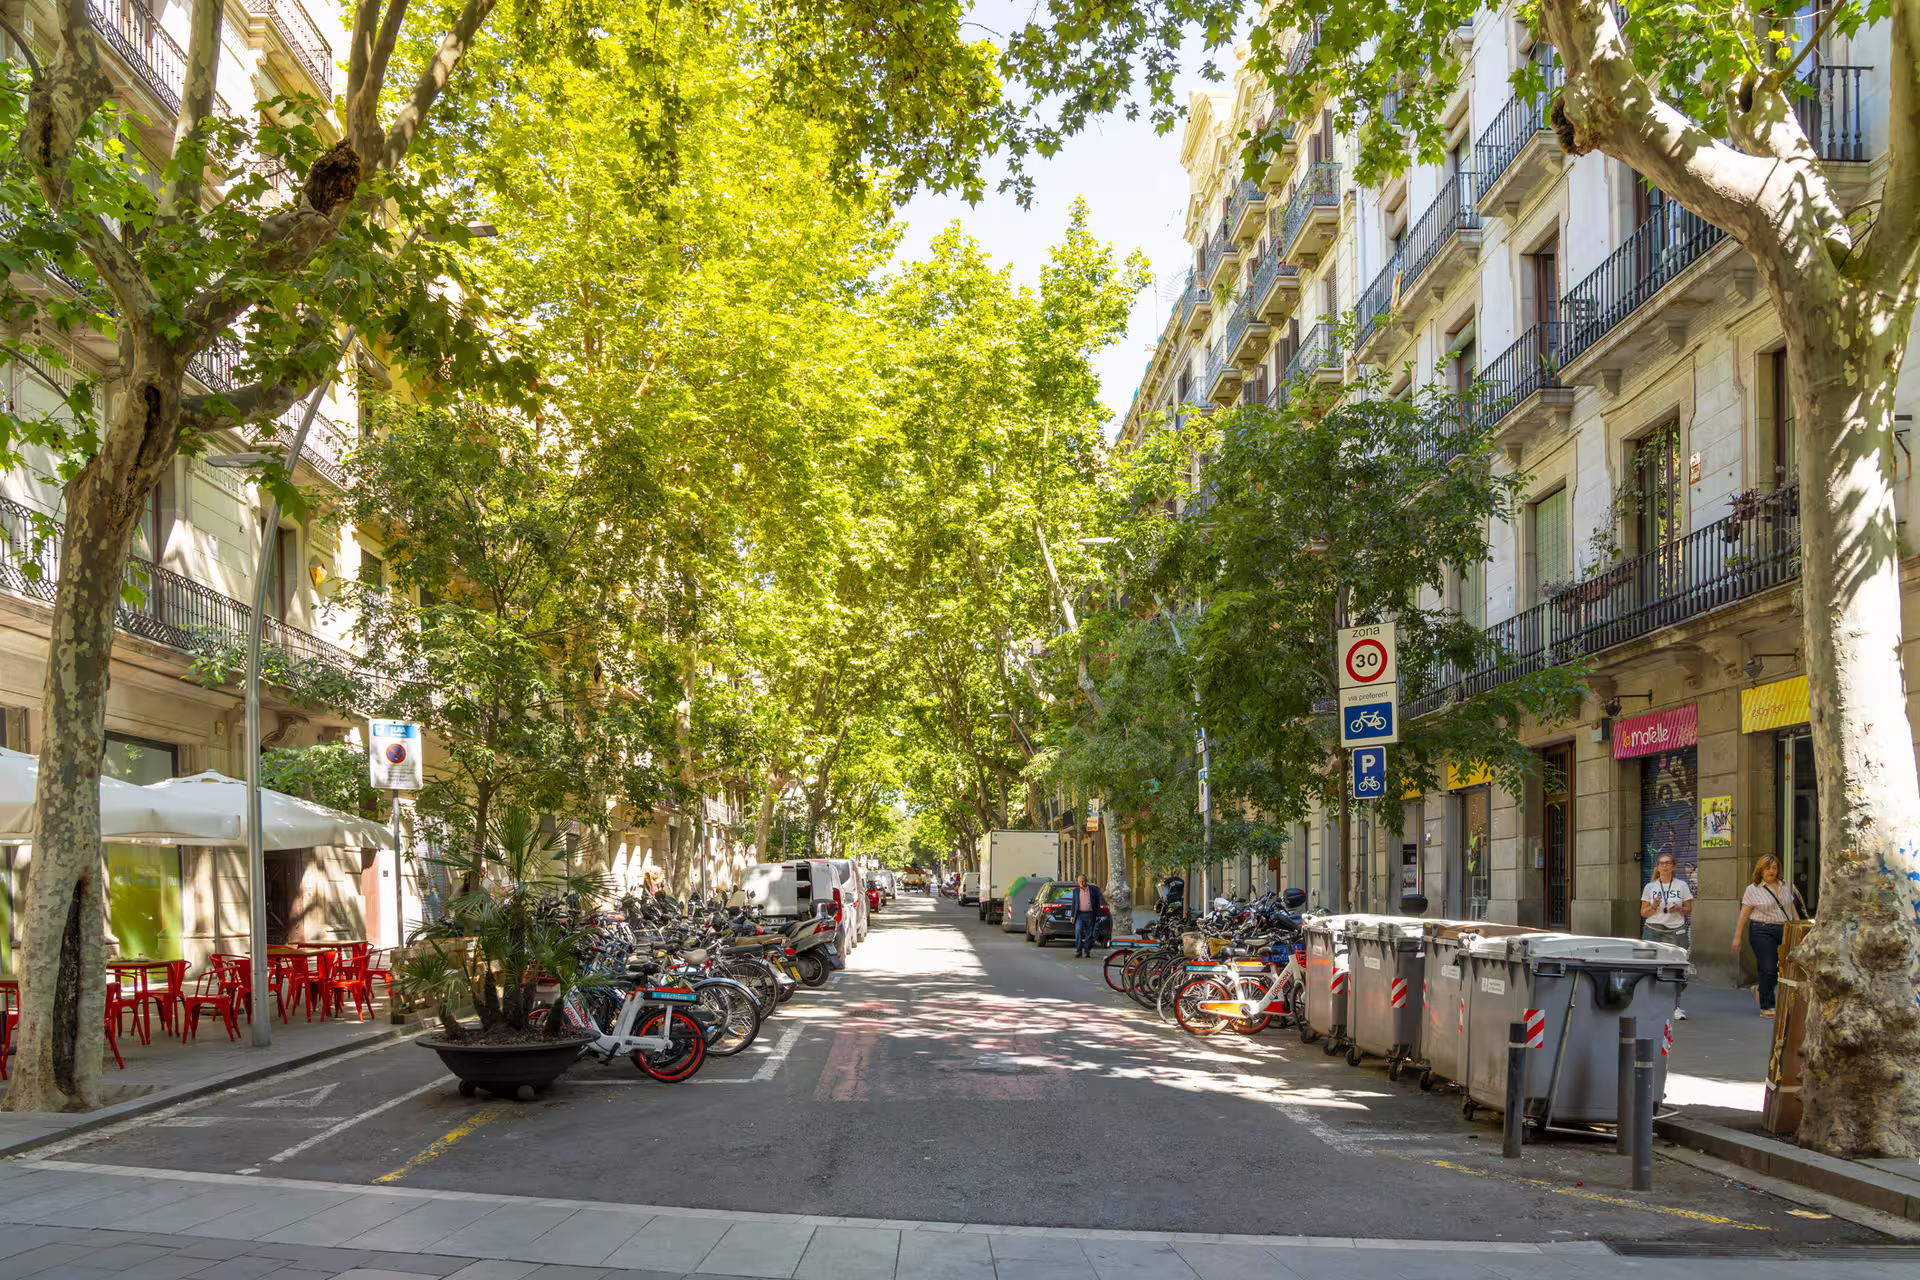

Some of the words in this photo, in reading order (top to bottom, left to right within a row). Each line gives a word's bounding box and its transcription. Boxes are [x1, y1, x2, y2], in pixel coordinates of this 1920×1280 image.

[1352, 626, 1380, 638] zona
[1356, 653, 1378, 668] 30
[1358, 691, 1388, 701] preferent
[1621, 731, 1631, 748] la
[1631, 722, 1669, 748] marelle
[1361, 754, 1376, 774] P
[1652, 889, 1682, 899] PAUSE
